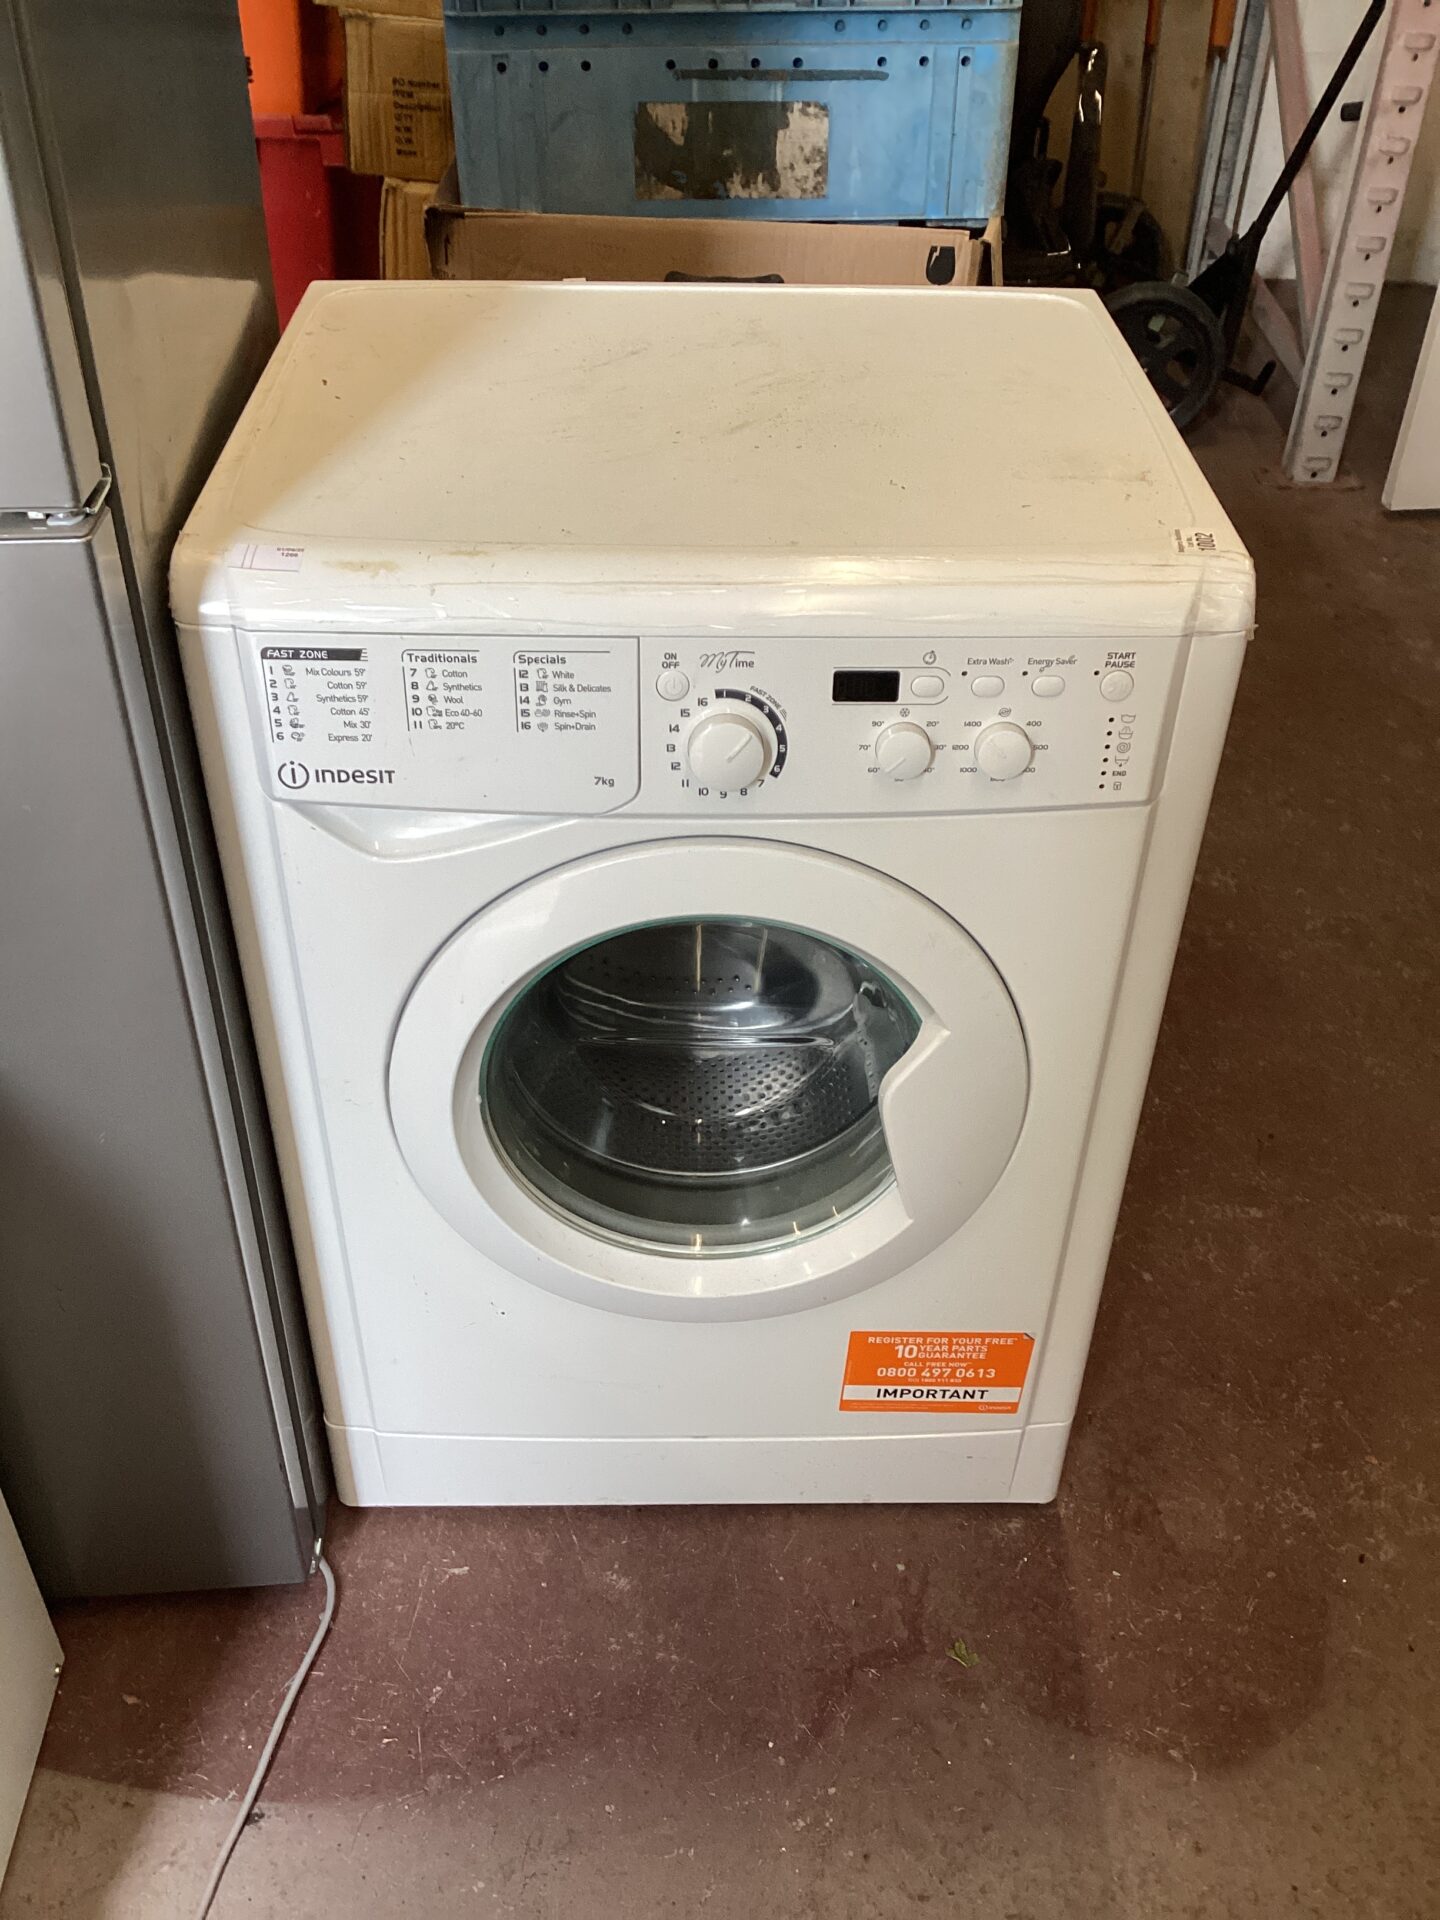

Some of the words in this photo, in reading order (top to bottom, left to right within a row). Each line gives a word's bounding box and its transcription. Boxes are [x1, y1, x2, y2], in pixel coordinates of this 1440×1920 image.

[1195, 532, 1216, 551] 1002
[267, 650, 294, 658] FAST
[300, 650, 328, 659] ZONE
[407, 652, 477, 664] Traditionals
[664, 652, 677, 660] ON
[1107, 652, 1136, 660] START
[518, 654, 566, 666] Specials
[1028, 658, 1054, 667] Energy
[1055, 657, 1078, 665] Saver
[1104, 660, 1135, 668] PAUSE
[269, 666, 273, 675] 1
[306, 668, 320, 676] Mix
[321, 668, 352, 676] Colours
[410, 668, 417, 677] 7
[442, 670, 468, 678] Cotton
[519, 670, 528, 678] 12
[552, 670, 574, 679] White
[269, 680, 278, 688] 2
[327, 681, 353, 690] Cotton
[411, 682, 419, 690] 8
[442, 682, 482, 692] Synthetics
[553, 684, 567, 692] Silk
[568, 684, 575, 692] &
[577, 684, 611, 692] Delicates
[271, 692, 278, 702] 3
[316, 694, 356, 704] Synthetics
[412, 694, 420, 703] 9
[444, 695, 464, 704] Wool
[520, 696, 530, 704] 14
[554, 697, 572, 706] Gym
[698, 697, 708, 706] 16
[744, 694, 752, 702] 2
[750, 686, 767, 697] FAST
[766, 694, 782, 710] ZONE
[272, 706, 281, 714] 4
[330, 708, 356, 716] Cotton
[411, 708, 422, 716] 10
[445, 709, 459, 717] Eco
[460, 708, 482, 717] 40-60
[520, 709, 530, 718] 15
[554, 709, 596, 719] Rinse+Spin
[680, 708, 690, 717] 15
[763, 705, 769, 713] 3
[274, 719, 282, 727] 5
[343, 721, 357, 729] Mix
[413, 721, 422, 729] 11
[521, 722, 531, 730] 16
[554, 722, 596, 732] Spin+Drain
[669, 724, 680, 733] 14
[776, 723, 782, 731] 4
[276, 732, 284, 740] 6
[328, 734, 358, 743] Express
[779, 744, 786, 752] 5
[671, 762, 681, 770] 12
[315, 769, 395, 784] INDESIT
[594, 776, 615, 787] 7kg
[757, 779, 764, 787] 7
[698, 788, 709, 796] 10
[740, 788, 748, 796] 8
[868, 1336, 924, 1344] REGISTER
[952, 1337, 981, 1345] YOUR
[894, 1344, 918, 1359] 10
[877, 1367, 916, 1377] 0800
[921, 1368, 952, 1377] 497
[956, 1368, 996, 1378] 0613
[876, 1388, 989, 1399] IMPORTANT
